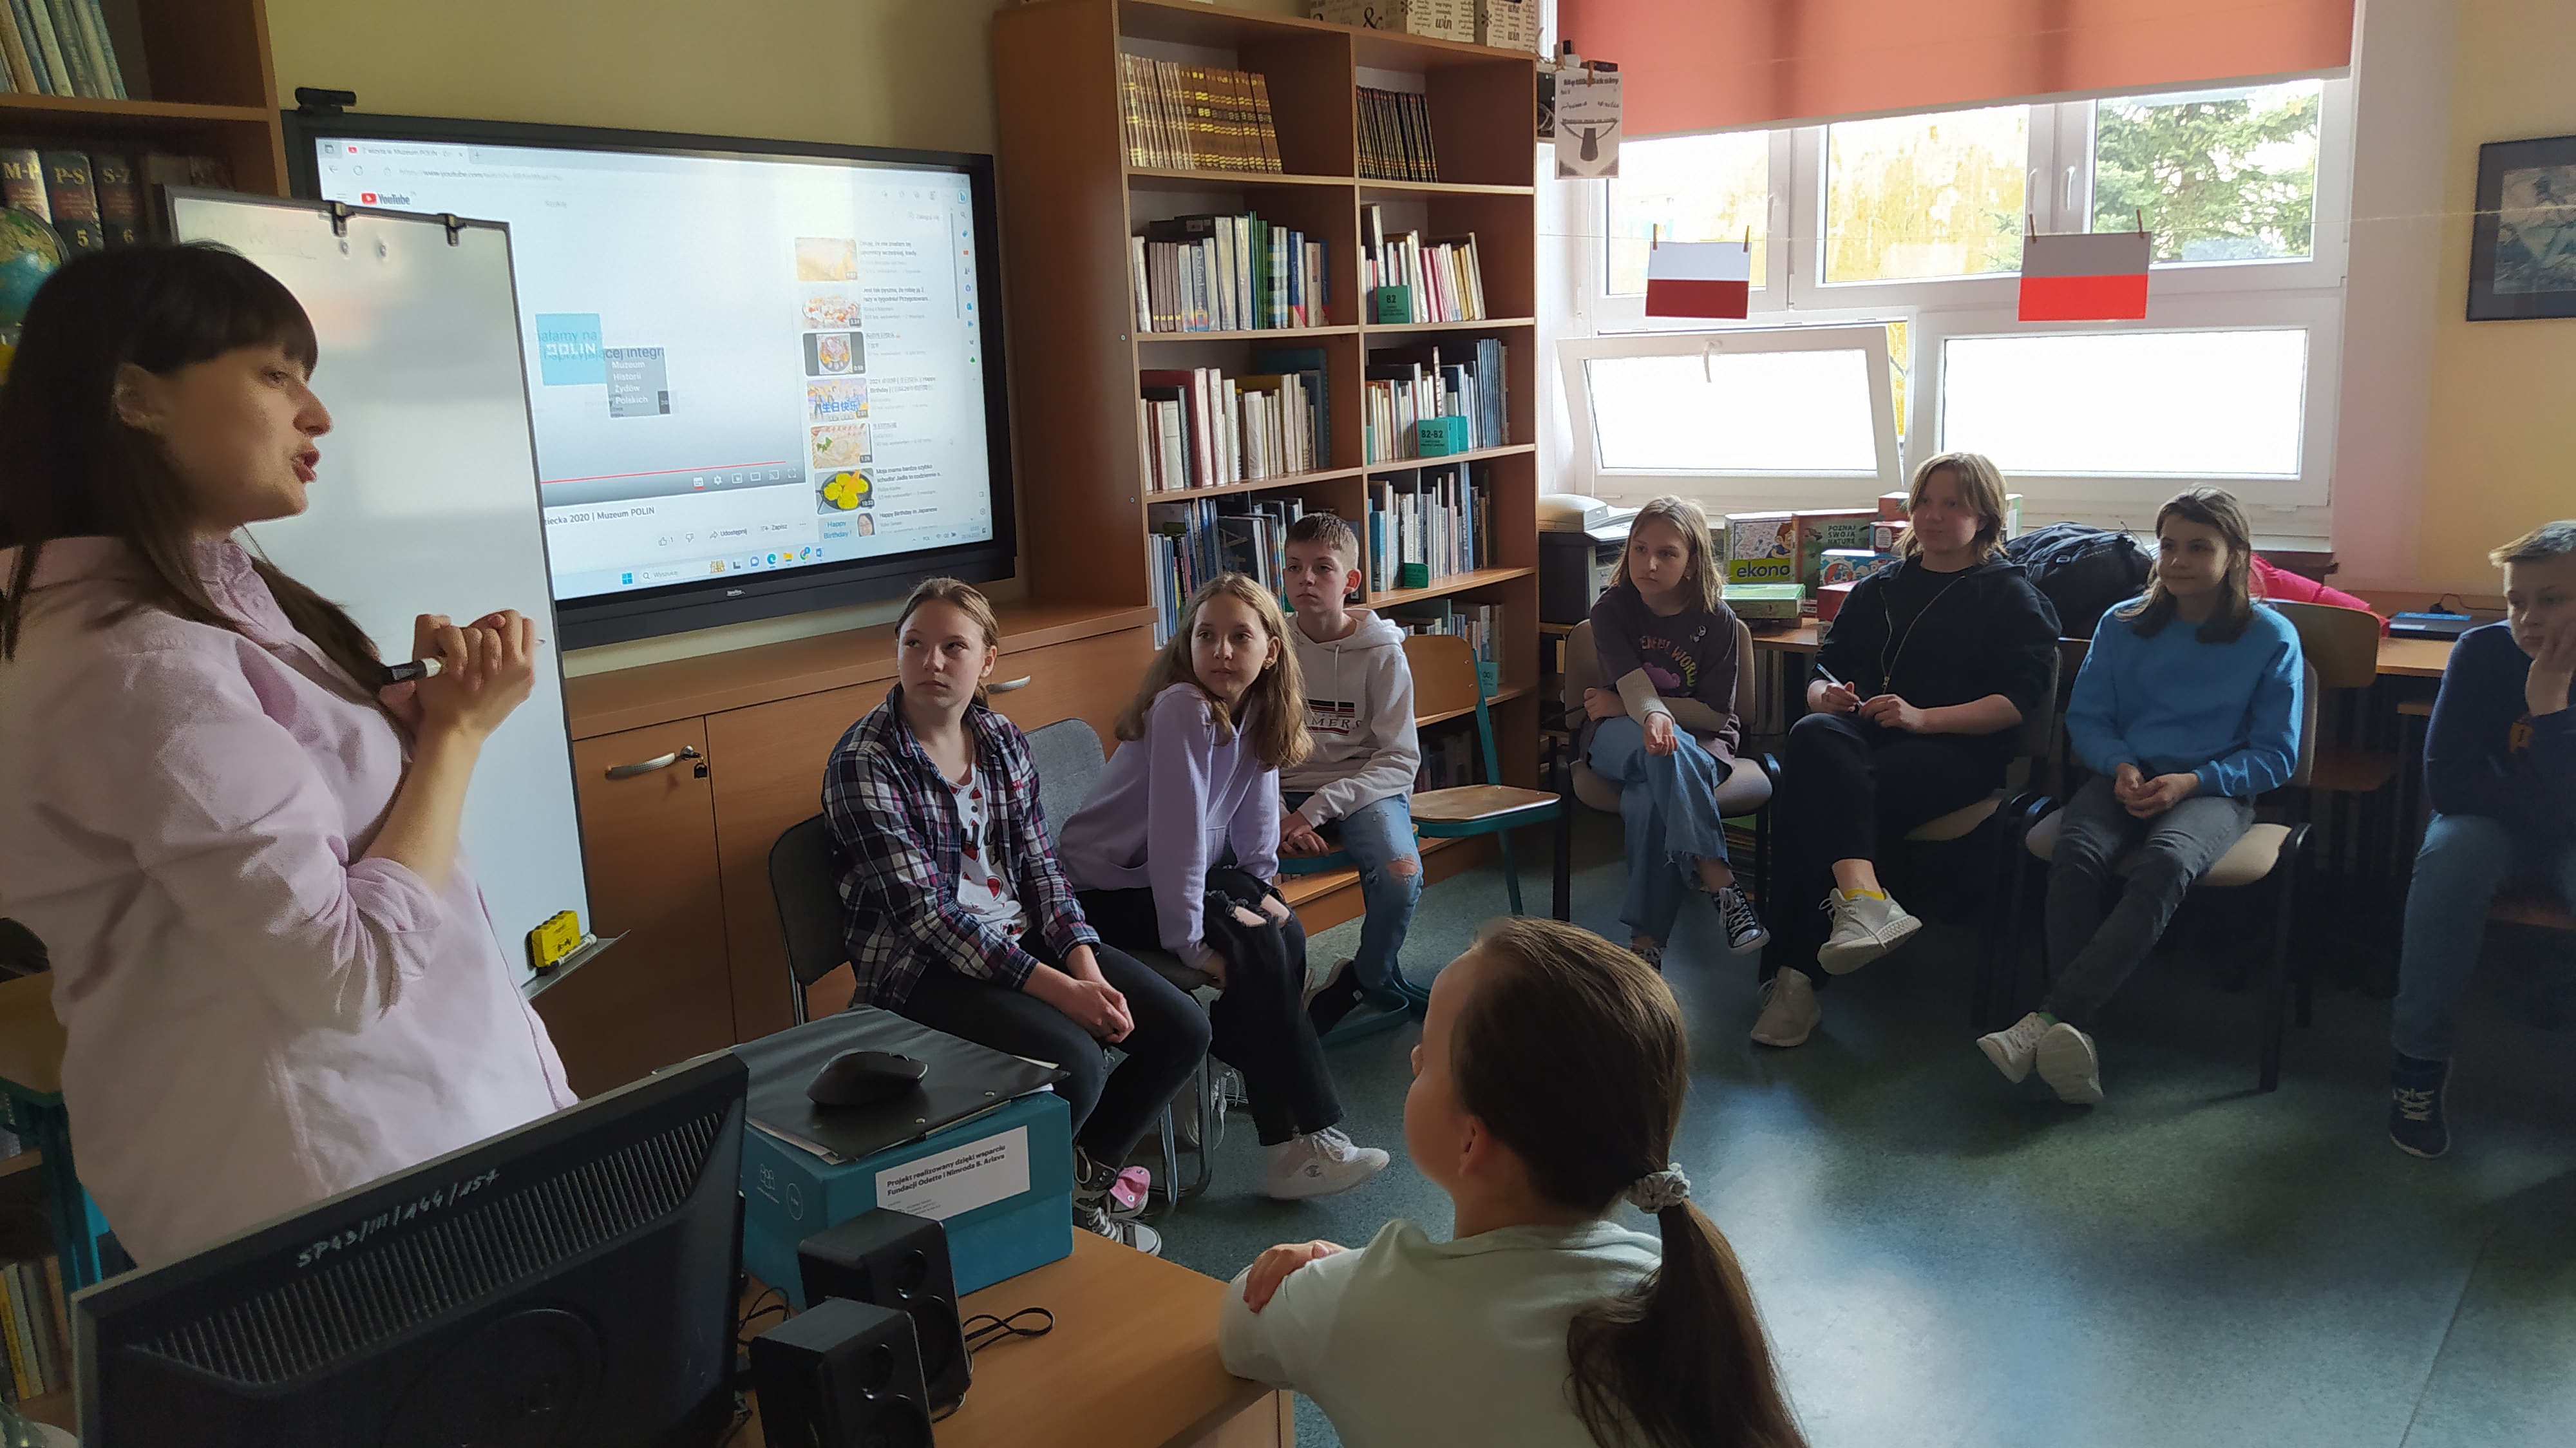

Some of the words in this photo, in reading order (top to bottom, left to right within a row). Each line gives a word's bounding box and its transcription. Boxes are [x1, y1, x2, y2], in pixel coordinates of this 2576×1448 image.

[2, 162, 40, 180] M-P
[53, 167, 86, 185] P-S
[377, 193, 411, 205] YouTube
[76, 229, 90, 247] 5
[122, 228, 135, 244] 6
[1386, 294, 1397, 303] 82
[582, 330, 598, 340] na
[611, 361, 645, 369] Muzeum
[612, 372, 641, 381] Historii
[614, 383, 641, 394] Żydów
[615, 395, 649, 405] Polskich
[822, 401, 860, 414] 生日快乐
[1421, 430, 1444, 439] 82-82
[569, 512, 590, 523] 2020
[597, 510, 629, 520] Muzeum
[630, 506, 656, 517] POLIN
[720, 528, 748, 537] Udostępnij
[1736, 562, 1790, 579] ekono
[887, 1175, 913, 1187] Projekt
[913, 1161, 954, 1179] realizowany
[955, 1154, 975, 1167] dzięki
[976, 1144, 1006, 1159] wsparciu
[887, 1180, 917, 1196] Fundacji
[918, 1174, 942, 1186] Odette
[946, 1163, 975, 1177] Nimroda
